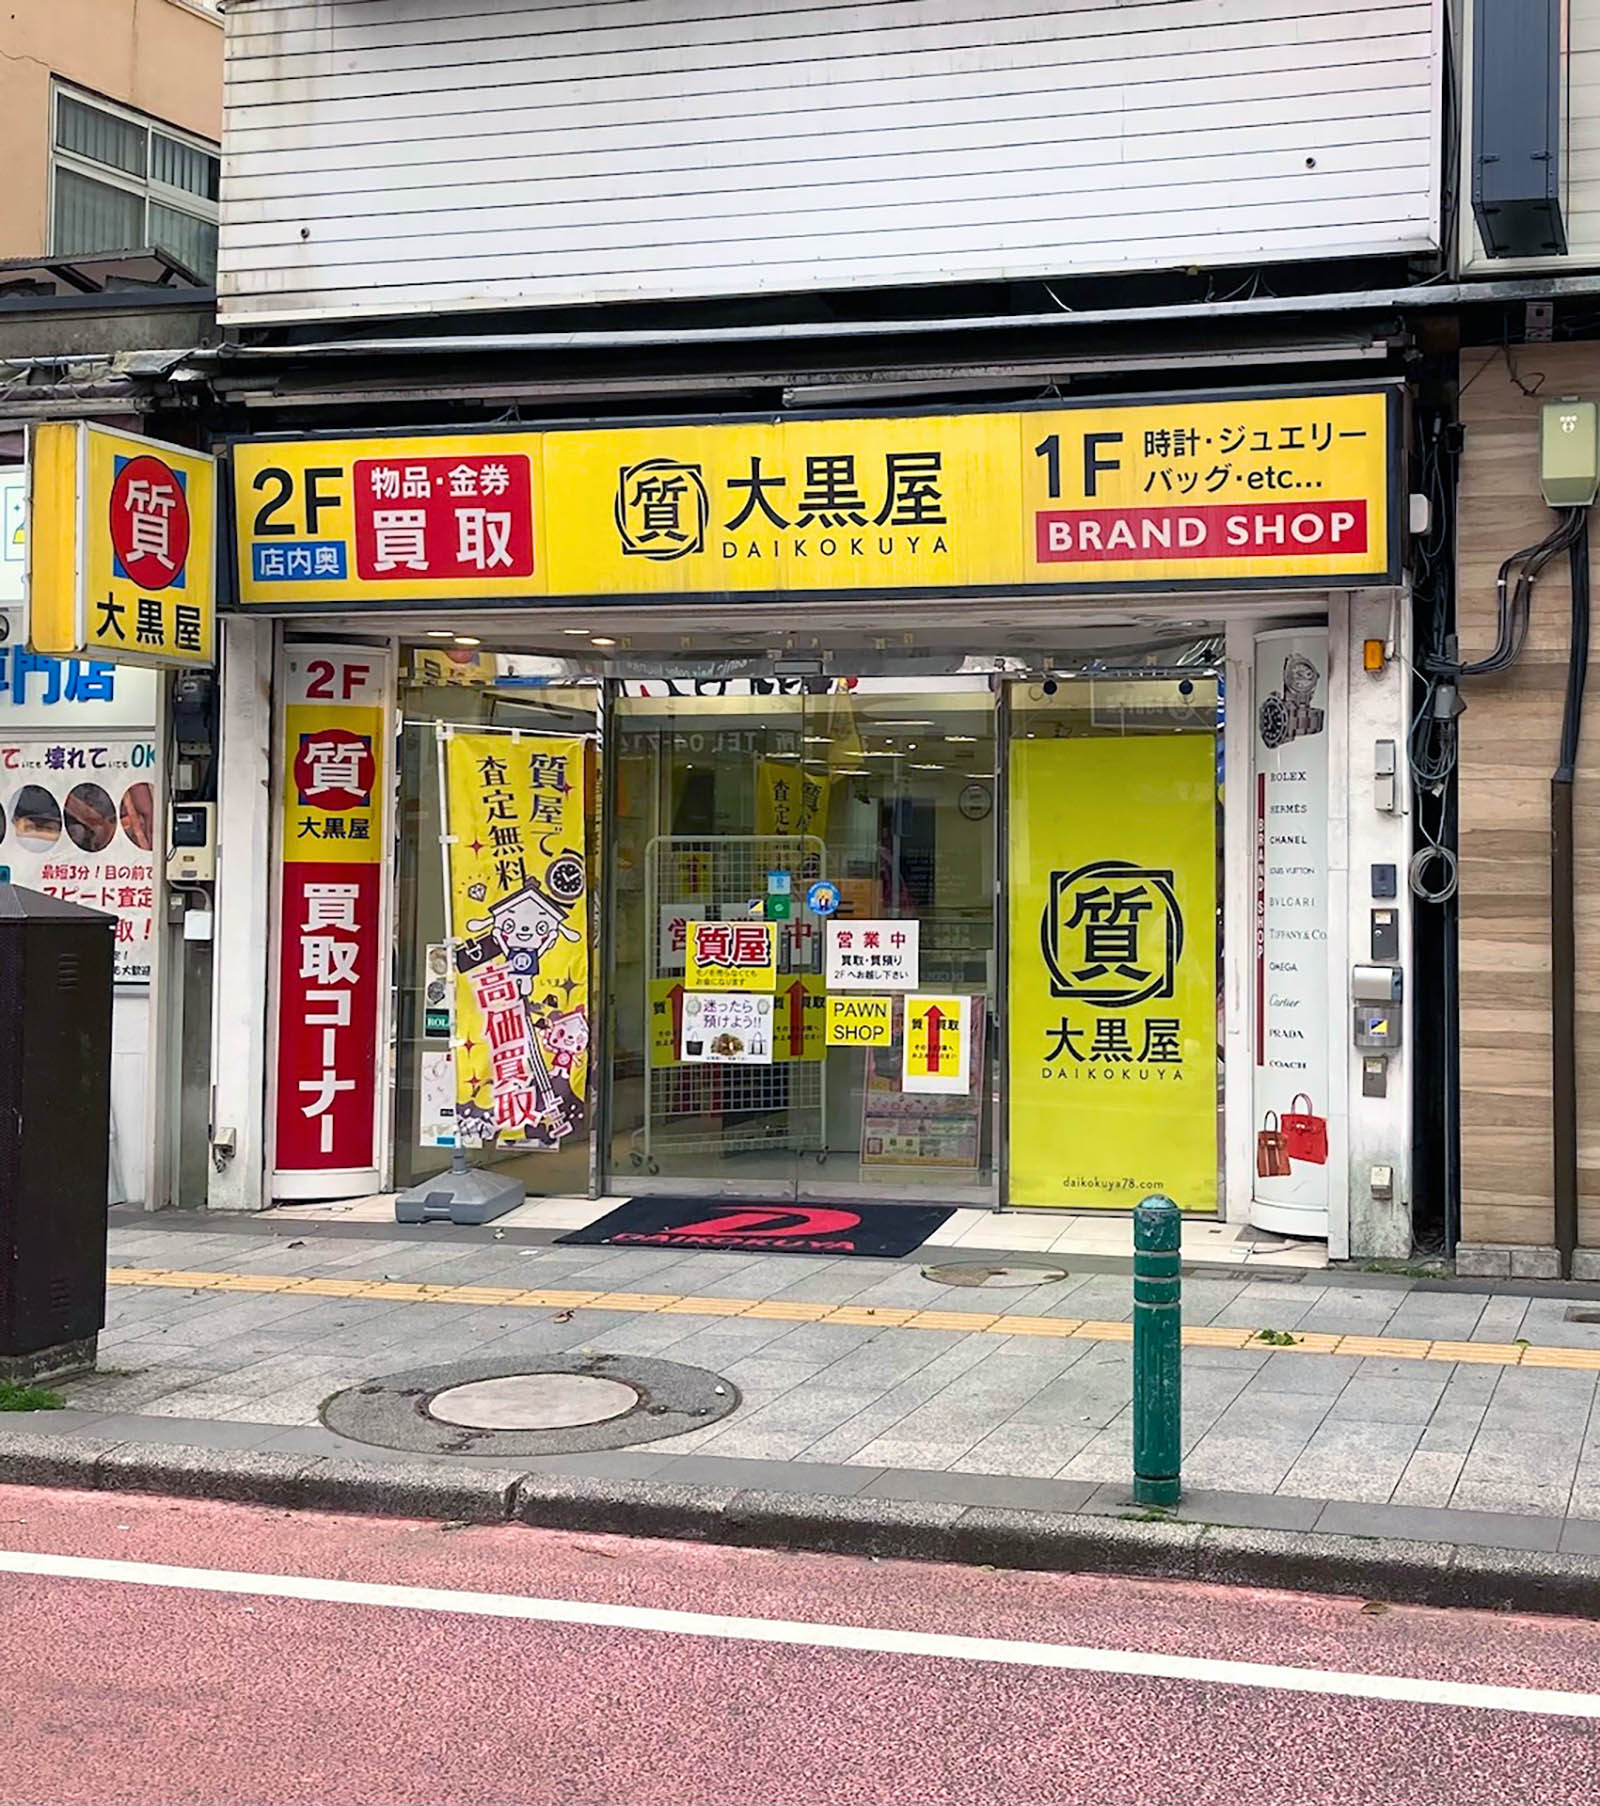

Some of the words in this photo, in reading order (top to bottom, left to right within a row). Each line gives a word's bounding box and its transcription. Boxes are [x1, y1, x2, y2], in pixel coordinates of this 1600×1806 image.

[1143, 422, 1367, 458] 時計・ジュエリー
[371, 463, 510, 500] 物品・金券
[1035, 432, 1123, 499] 1F
[253, 467, 344, 536] 2F
[630, 475, 688, 543] 質
[724, 452, 947, 531] 大黒屋
[124, 479, 176, 571] 質
[373, 507, 515, 572] 買取
[1048, 517, 1207, 552] BRAND
[1227, 512, 1356, 546] SHOP
[260, 547, 340, 577] 店内奥
[722, 535, 948, 559] DAIKOKUYA
[96, 592, 201, 651] 大黒屋
[0, 644, 116, 706] 門店
[305, 660, 370, 700] 2F
[304, 741, 368, 797] 質
[1270, 771, 1307, 782] ROLEX
[475, 754, 528, 892] 査定無料
[528, 752, 570, 858] 質屋で
[297, 816, 370, 840] 大黒屋
[1269, 835, 1307, 845] CHANEL
[696, 926, 769, 966] 質屋
[837, 930, 907, 950] 営業中
[1064, 885, 1153, 982] 質
[298, 883, 361, 1153] 買取コーナー
[703, 999, 753, 1014] 迷ったら
[833, 1002, 887, 1018] PAWN
[471, 963, 548, 1129] 高価買取
[833, 1024, 885, 1041] SHOP
[1044, 1016, 1184, 1063] 大黒屋
[1269, 1029, 1304, 1040] PRADA
[1041, 1067, 1184, 1081] DAIKOKUYA
[1269, 1060, 1307, 1069] COACH
[1062, 1176, 1165, 1192] daikokuya78.com
[609, 1232, 857, 1251] DAIKOKUYA
